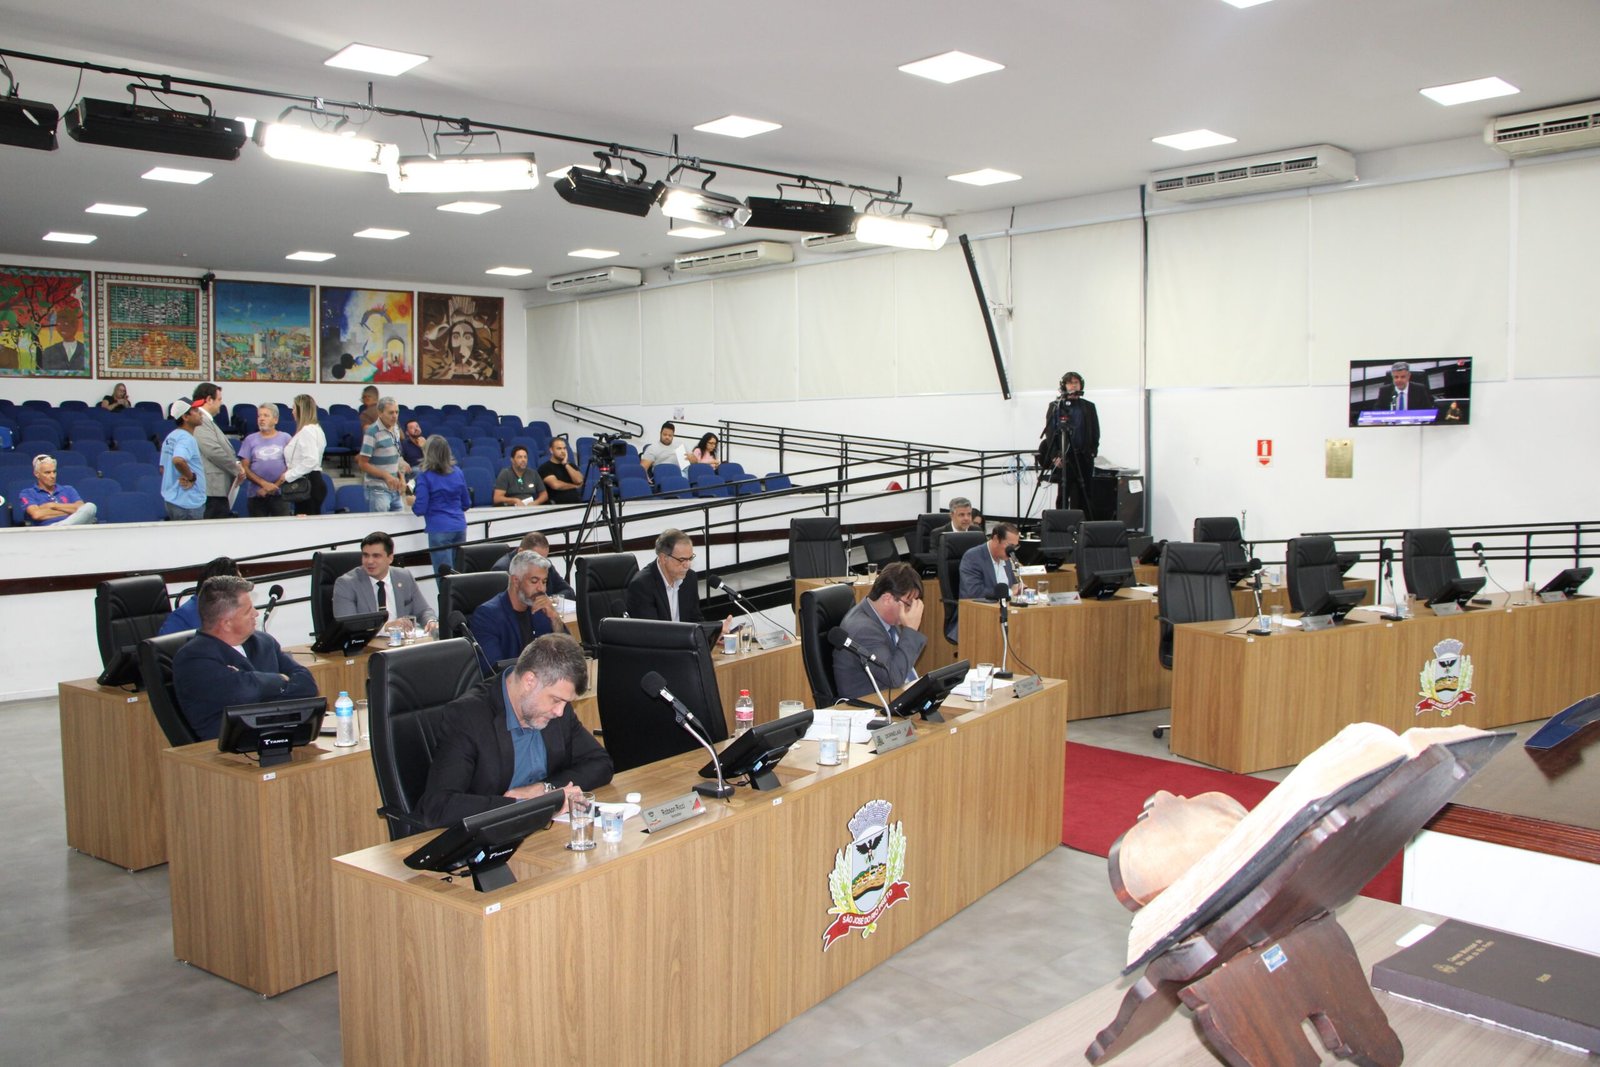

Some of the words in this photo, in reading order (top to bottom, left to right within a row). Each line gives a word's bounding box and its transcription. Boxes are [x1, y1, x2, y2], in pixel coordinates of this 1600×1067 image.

[842, 914, 853, 924] SÃO
[852, 916, 864, 925] JOSÉ
[878, 889, 893, 910] PRETO
